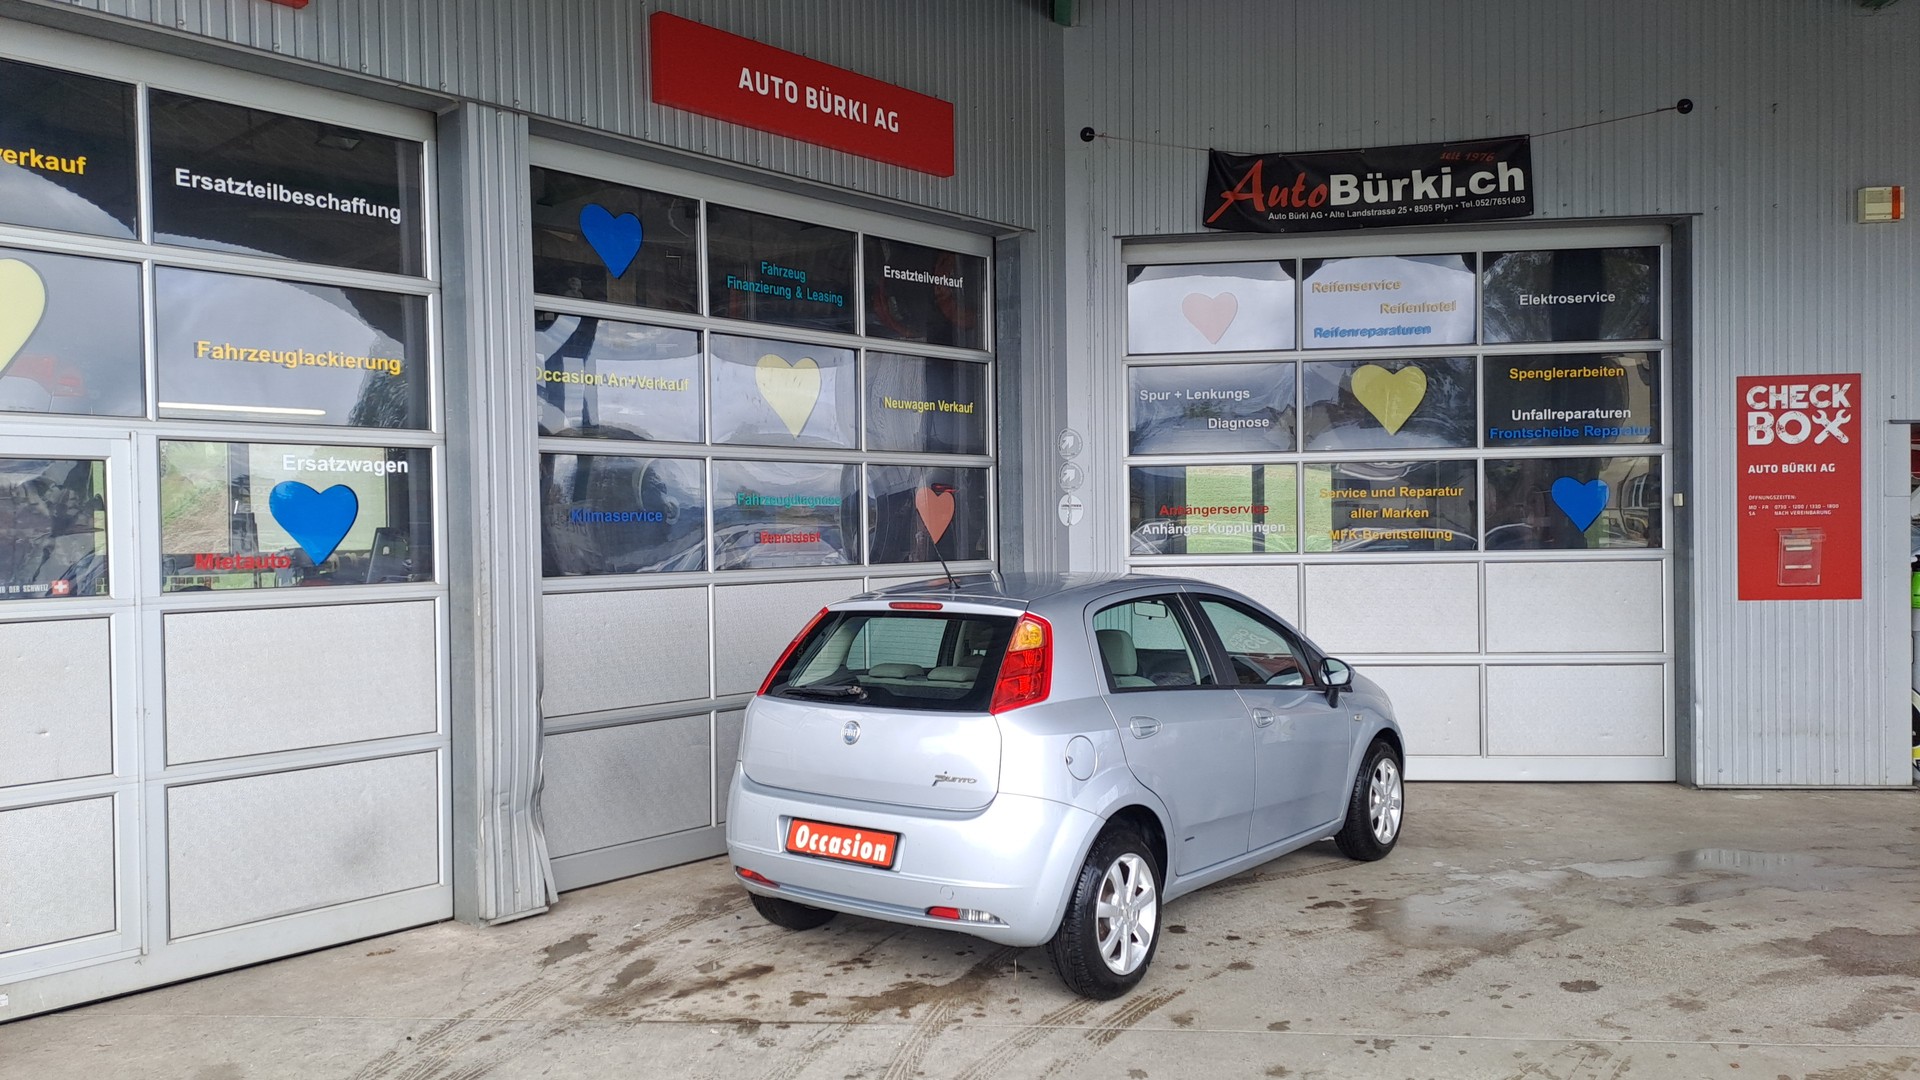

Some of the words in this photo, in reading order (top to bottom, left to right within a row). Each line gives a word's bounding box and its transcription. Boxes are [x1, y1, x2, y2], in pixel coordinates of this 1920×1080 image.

[738, 67, 799, 104] AUTO
[805, 86, 868, 125] BÜRKI
[874, 108, 900, 133] AG
[1466, 152, 1495, 161] 1976
[174, 167, 402, 225] Ersatzteilbeschaffung
[1268, 212, 1287, 220] Auto
[1288, 211, 1309, 220] Bürki
[1310, 211, 1323, 219] AG
[1329, 210, 1345, 218] Alte
[1346, 207, 1396, 218] Landstrasse
[1397, 206, 1408, 215] 25
[1414, 204, 1433, 213] 8505
[1435, 203, 1454, 212] Pfyn
[760, 260, 807, 283] Fahrzeug
[883, 265, 964, 289] Ersatzteilverkauf
[726, 274, 792, 300] Finanzierung
[795, 286, 803, 299] &
[806, 287, 844, 306] Leasing
[1311, 279, 1402, 294] Reifenservice
[1519, 291, 1616, 306] Elektroservice
[1380, 300, 1457, 315] Reifenhotel
[1313, 324, 1432, 339] Reifenreparaturen
[195, 340, 402, 376] Fahrzeuglackierung
[1509, 366, 1625, 382] Spenglerarbeiten
[1139, 389, 1171, 403] Spur
[1173, 390, 1182, 400] +
[1186, 388, 1251, 402] Lenkungs
[1746, 383, 1852, 410] CHECK
[883, 395, 936, 414] Neuwagen
[937, 398, 974, 415] Verkauf
[1511, 408, 1632, 422] Unfallreparaturen
[1207, 417, 1270, 431] Diagnose
[1489, 426, 1580, 439] Frontscheibe
[1584, 425, 1653, 439] Reparatur
[282, 453, 409, 477] Ersatzwagen
[1748, 463, 1779, 474] AUTO
[1781, 462, 1817, 473] BÜRKI
[1820, 463, 1836, 473] AG
[1319, 487, 1367, 499] Service
[1371, 486, 1396, 498] und
[1399, 486, 1464, 499] Reparatur
[571, 507, 663, 523] Klimaservice
[1158, 503, 1270, 518] Anhängerservice
[1350, 508, 1378, 519] aller
[1381, 507, 1429, 519] Marken
[1141, 522, 1205, 537] Anhänger
[1207, 521, 1286, 536] Kupplungen
[1328, 528, 1453, 542] MFK-Bereitstellung
[194, 551, 292, 571] Mietauto
[9, 585, 21, 593] DER
[23, 584, 49, 592] SCHWEIZ
[795, 824, 887, 862] Occasion
